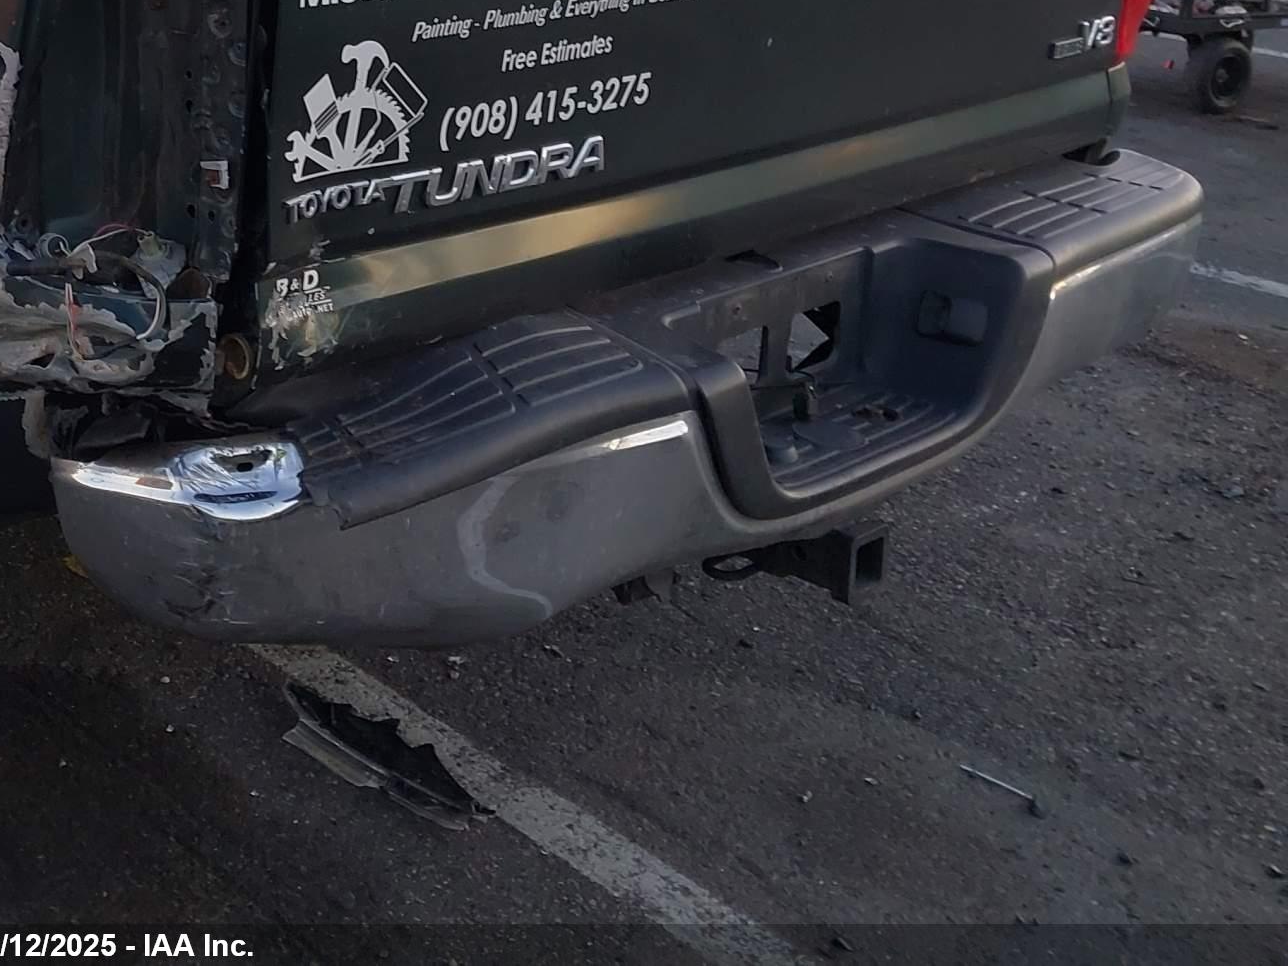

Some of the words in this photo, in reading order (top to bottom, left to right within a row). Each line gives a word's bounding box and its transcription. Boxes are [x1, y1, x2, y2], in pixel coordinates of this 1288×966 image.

[412, 15, 472, 42] Painting
[483, 3, 548, 29] Plumbing
[549, 0, 562, 19] &
[1079, 15, 1116, 48] V8
[501, 49, 537, 72] Free
[540, 35, 613, 65] Estimates
[439, 95, 518, 152] (908)
[525, 72, 652, 126] 415-3275
[283, 180, 386, 224] TOYOTA
[382, 135, 605, 214] TUNDRA
